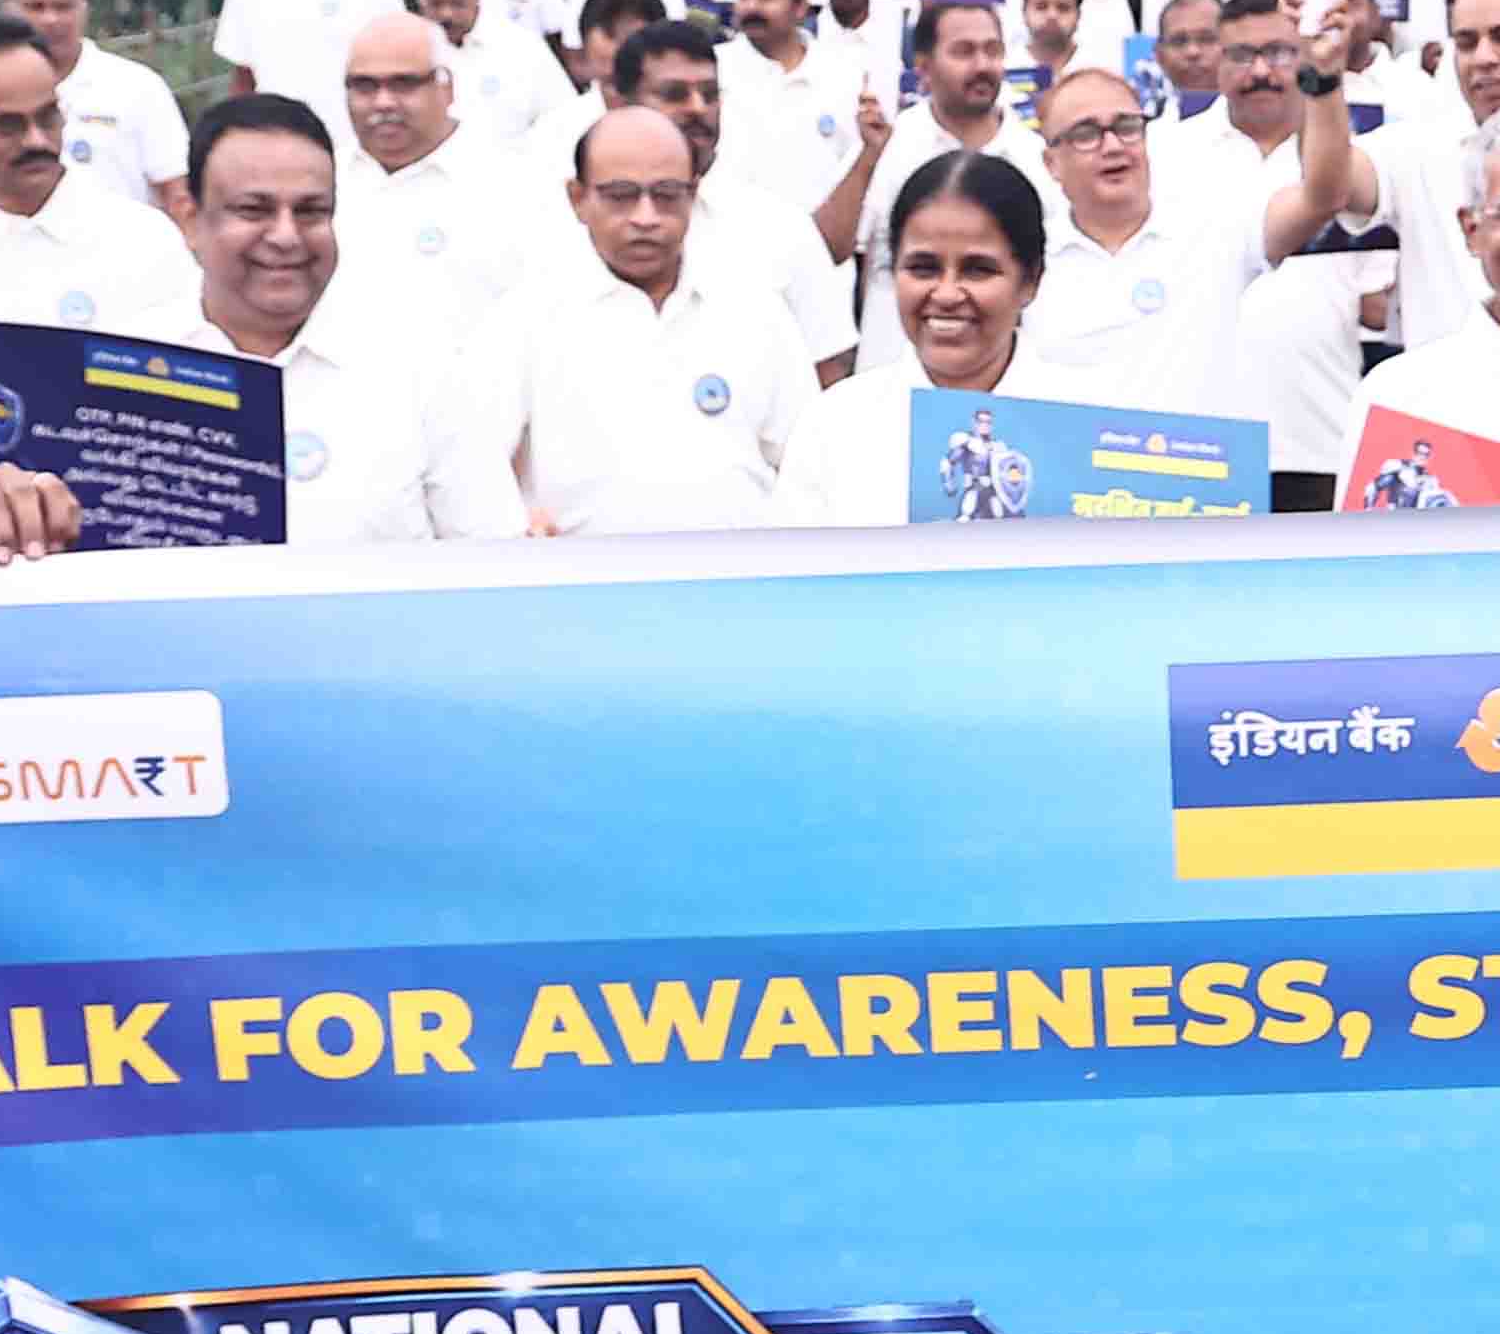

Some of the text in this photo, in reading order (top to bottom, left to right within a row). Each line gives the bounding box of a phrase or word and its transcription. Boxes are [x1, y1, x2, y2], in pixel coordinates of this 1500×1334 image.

[1208, 704, 1415, 765] इंडियन बैंक
[212, 991, 471, 1080] FOR
[515, 961, 1370, 1068] AWARENESS,
